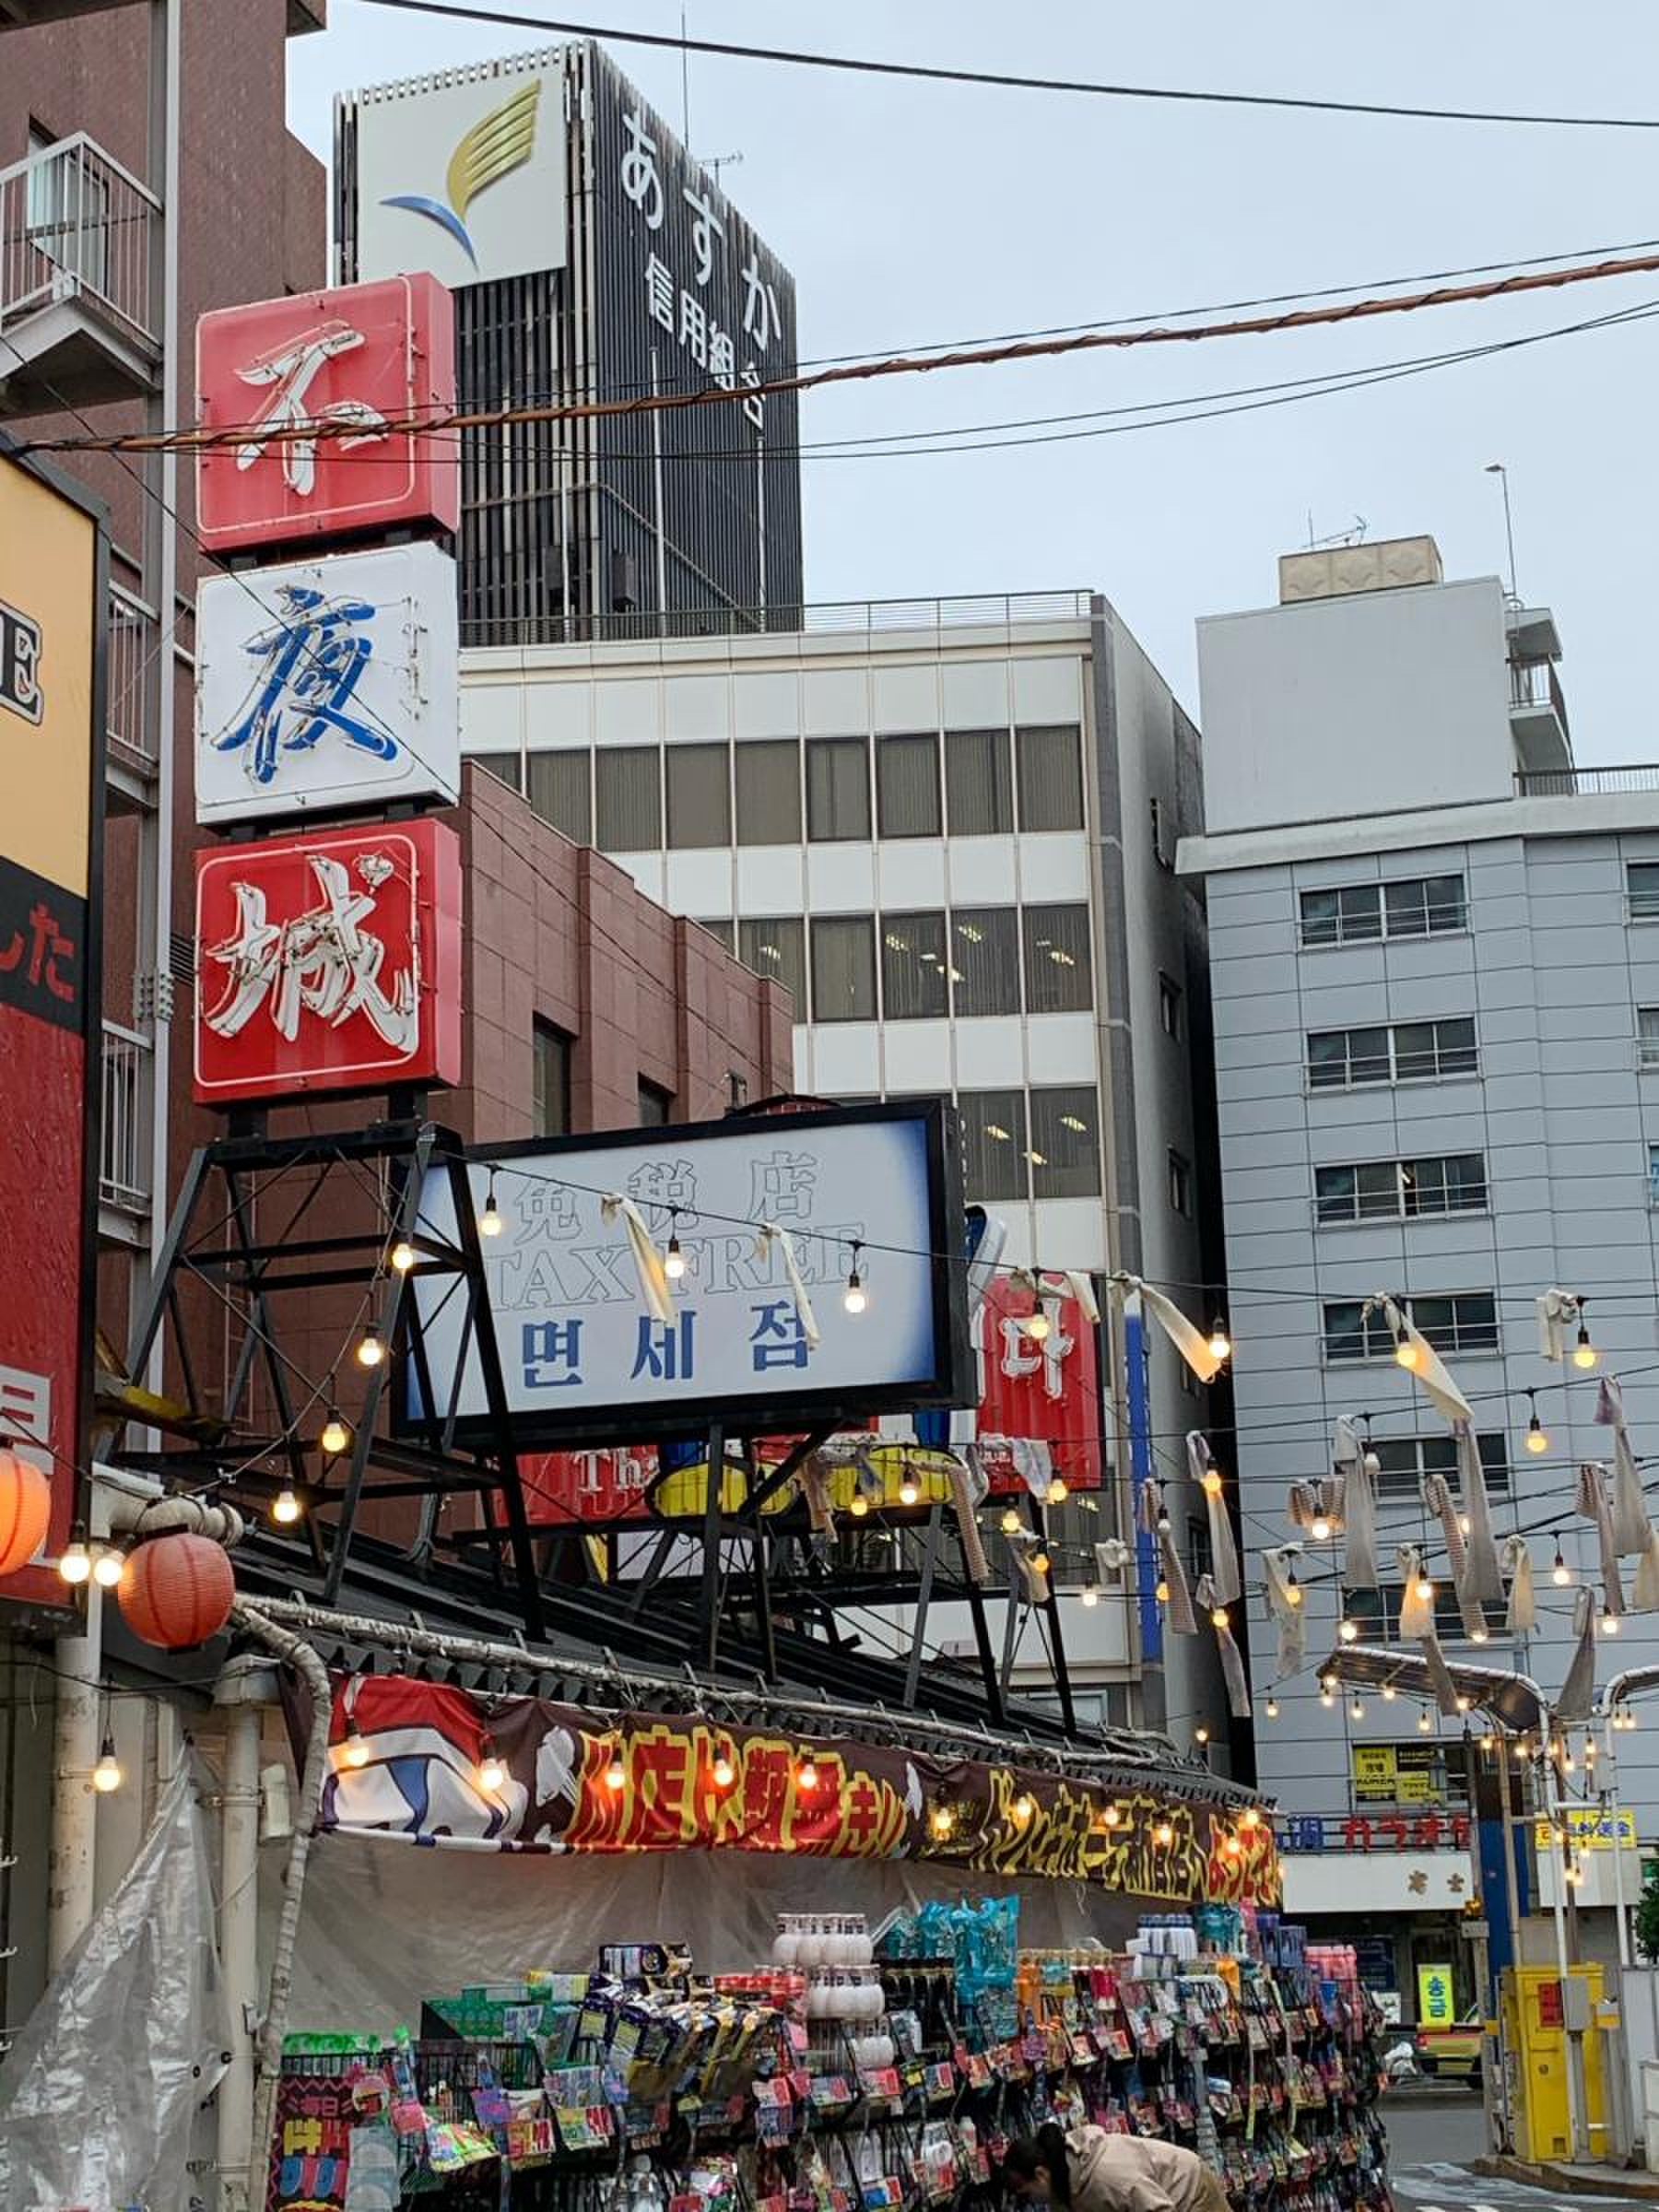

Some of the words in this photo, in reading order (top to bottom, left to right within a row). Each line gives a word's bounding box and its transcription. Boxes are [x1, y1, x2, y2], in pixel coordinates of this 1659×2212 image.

[621, 107, 781, 352] あすか
[644, 252, 766, 429] 信用組合
[513, 1150, 818, 1245] 免税店
[486, 1243, 637, 1313] TAX
[522, 1300, 809, 1389] 면세점
